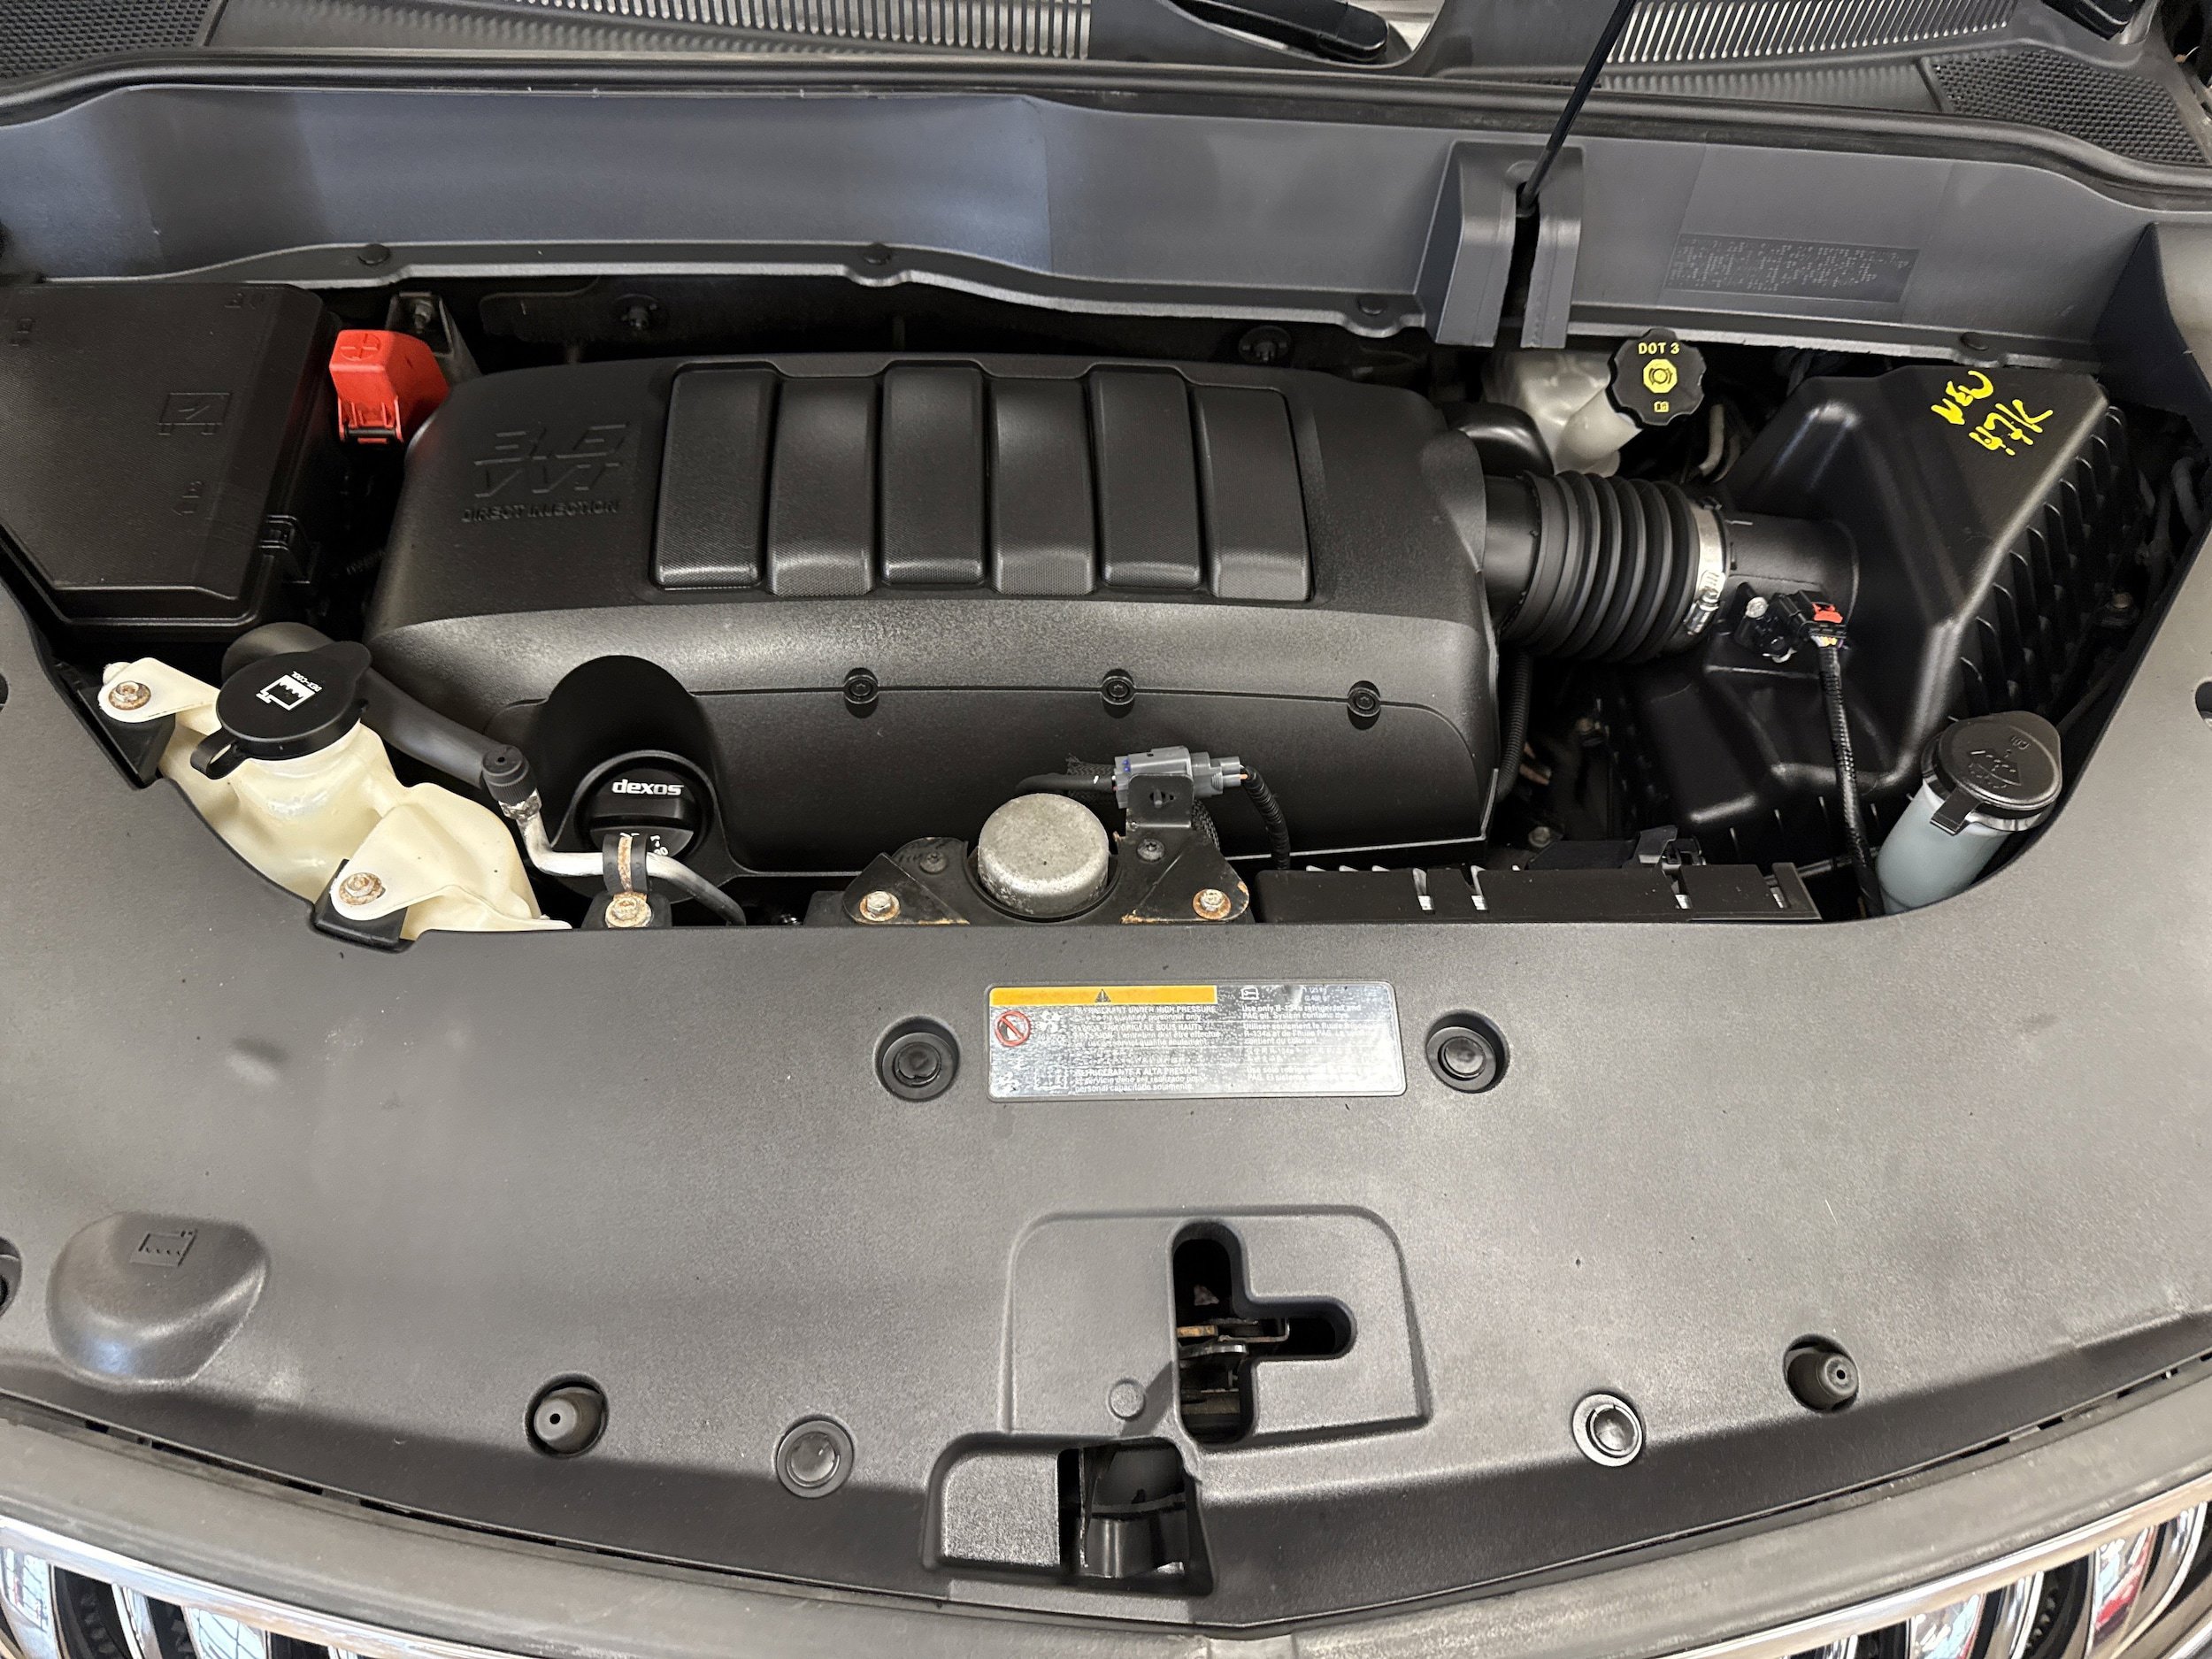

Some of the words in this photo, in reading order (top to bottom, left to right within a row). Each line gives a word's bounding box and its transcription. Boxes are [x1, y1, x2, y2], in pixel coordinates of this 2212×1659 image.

[1638, 342, 1666, 355] DOT
[1670, 342, 1680, 354] 3
[474, 462, 625, 498] VVT
[460, 503, 526, 524] DIRECT
[527, 499, 621, 518] INJECTION
[291, 671, 323, 693] DEX-COOL
[611, 779, 686, 796] dexos
[1257, 1004, 1274, 1013] only
[1075, 1085, 1109, 1094] personal
